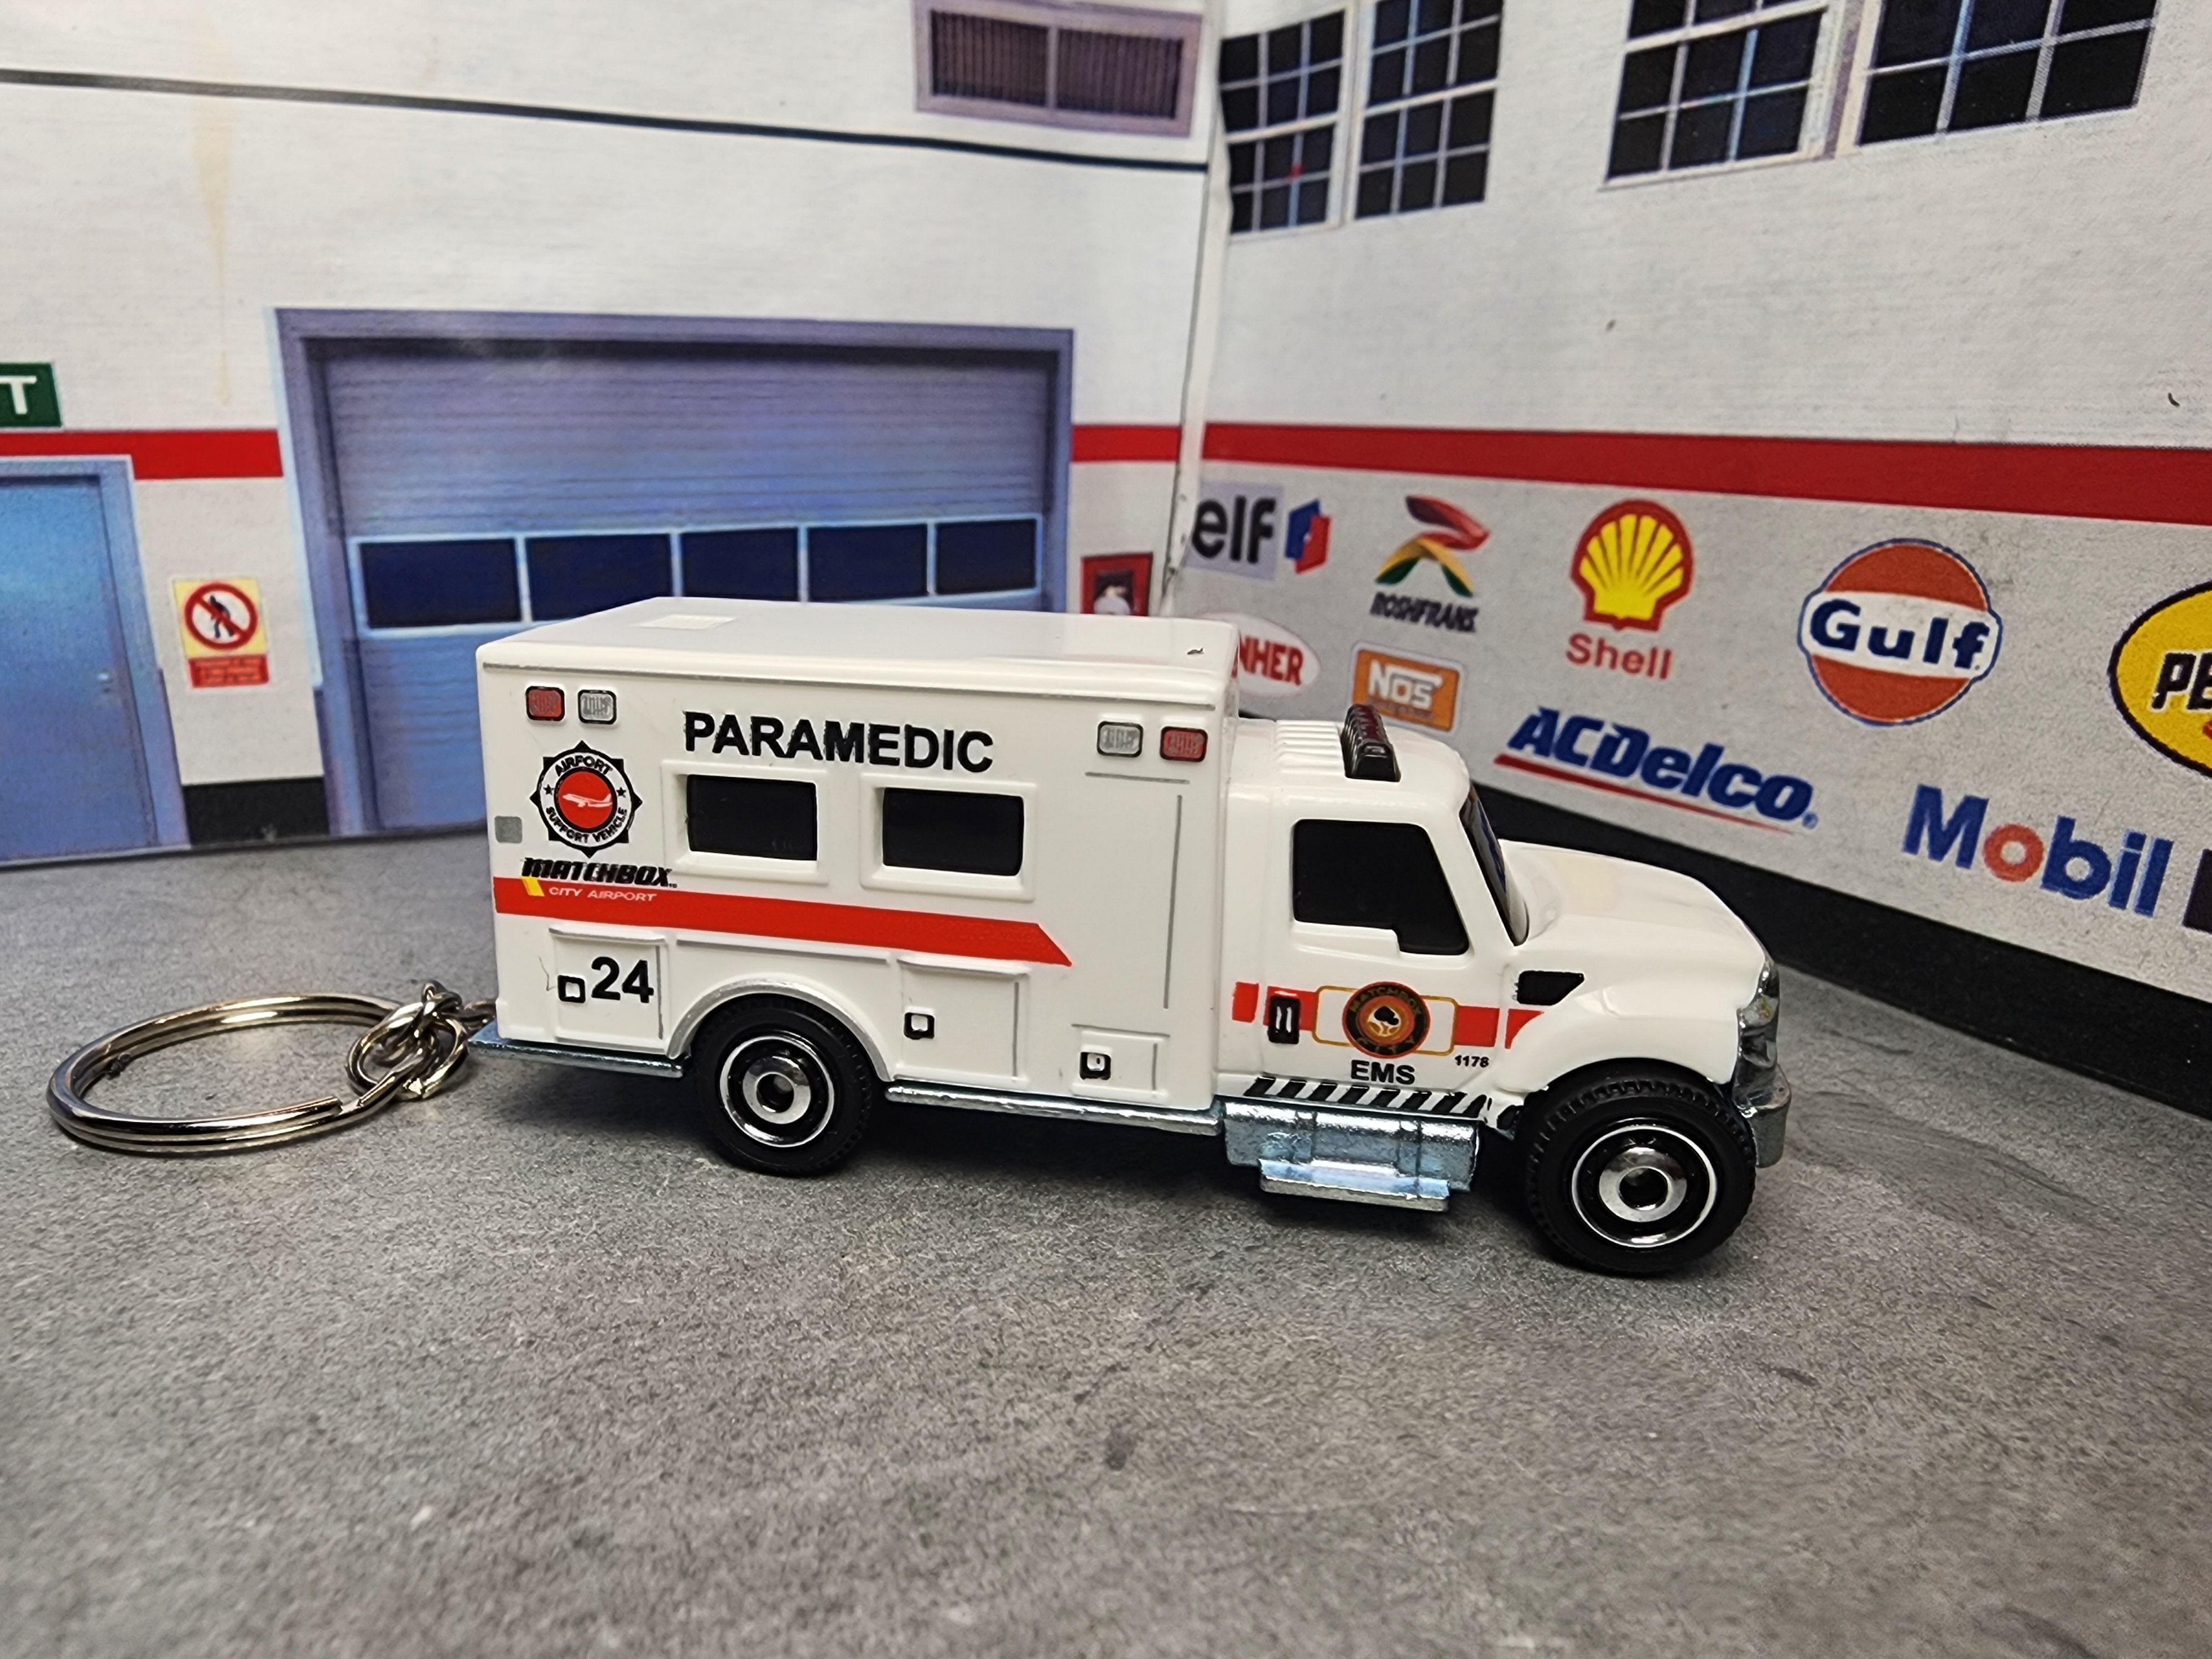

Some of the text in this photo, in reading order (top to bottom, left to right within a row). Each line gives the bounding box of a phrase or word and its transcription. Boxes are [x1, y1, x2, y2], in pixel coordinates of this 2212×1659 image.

[1192, 496, 1276, 564] elf
[1565, 633, 1672, 680] Shell
[1810, 599, 1990, 669] Gulf
[1368, 659, 1443, 710] NOS
[684, 711, 994, 773] PARAMEDIC
[1507, 706, 1814, 821] ACDelco
[555, 755, 613, 777] AIRPORT
[546, 806, 628, 843] SUPPORT VEHICLE
[521, 857, 673, 887] MATCHBOX
[1902, 784, 2174, 918] Mobil
[549, 886, 658, 901] CITY AIRPORT
[591, 957, 654, 1003] 24
[1350, 1059, 1416, 1085] EMS
[1454, 1055, 1490, 1068] 1178
